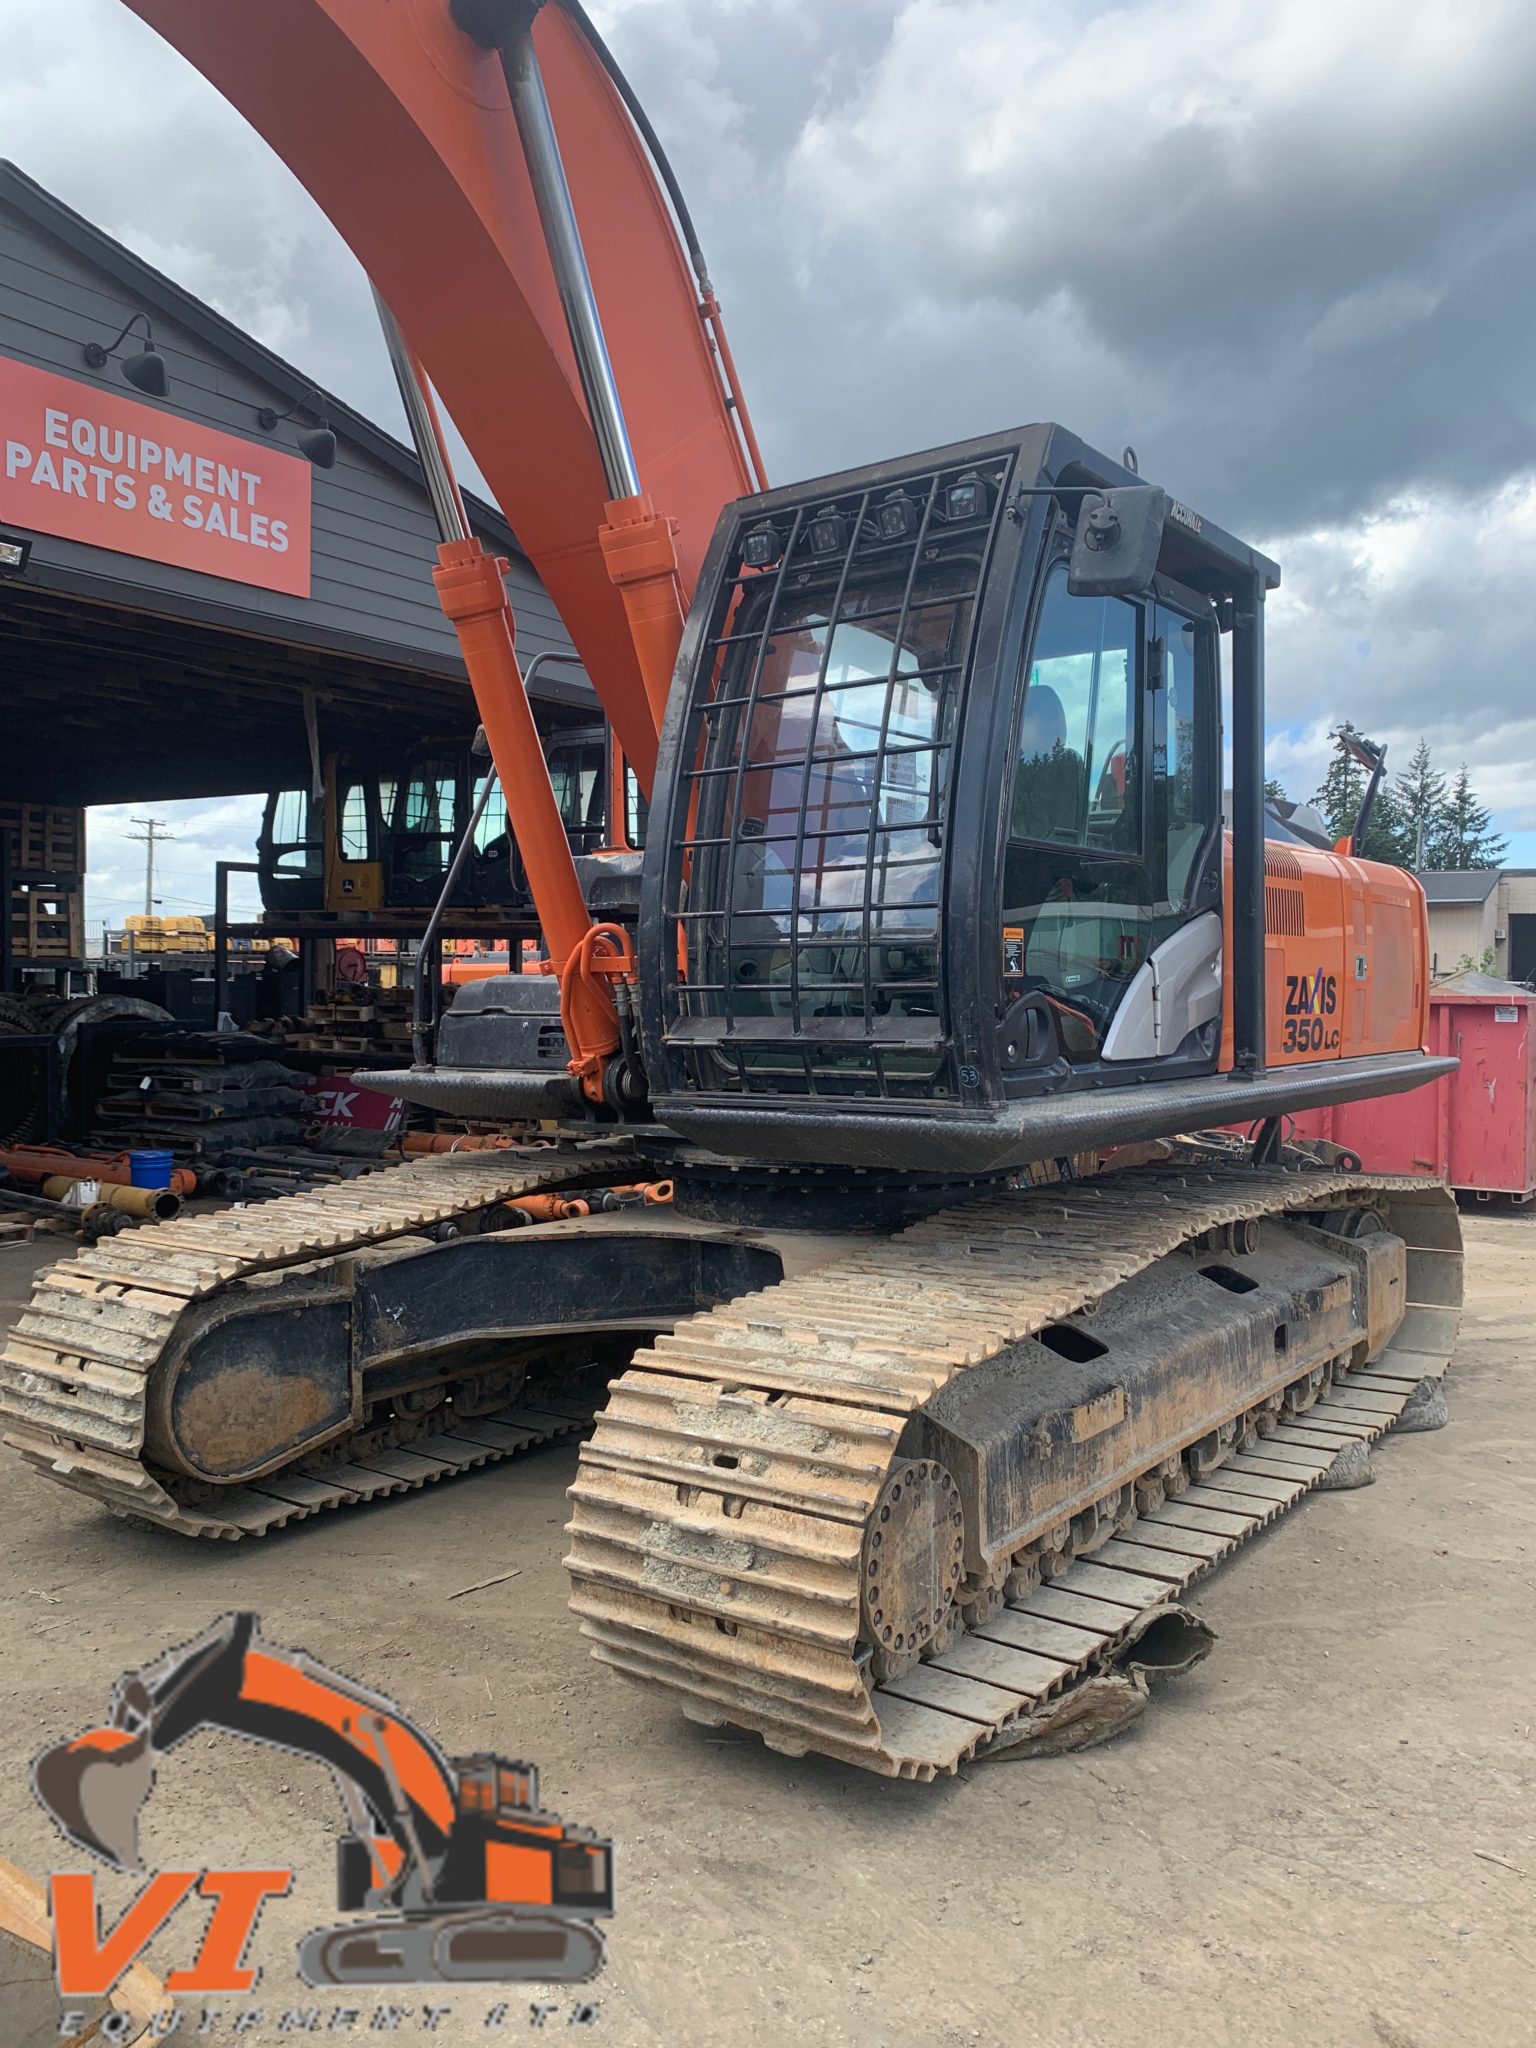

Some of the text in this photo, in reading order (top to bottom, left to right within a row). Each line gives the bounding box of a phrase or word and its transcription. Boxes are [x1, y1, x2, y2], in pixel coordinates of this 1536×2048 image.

[6, 441, 289, 552] PARTS & SALES
[45, 408, 261, 506] EQUIPMENT
[1285, 967, 1336, 1015] ZAXIS
